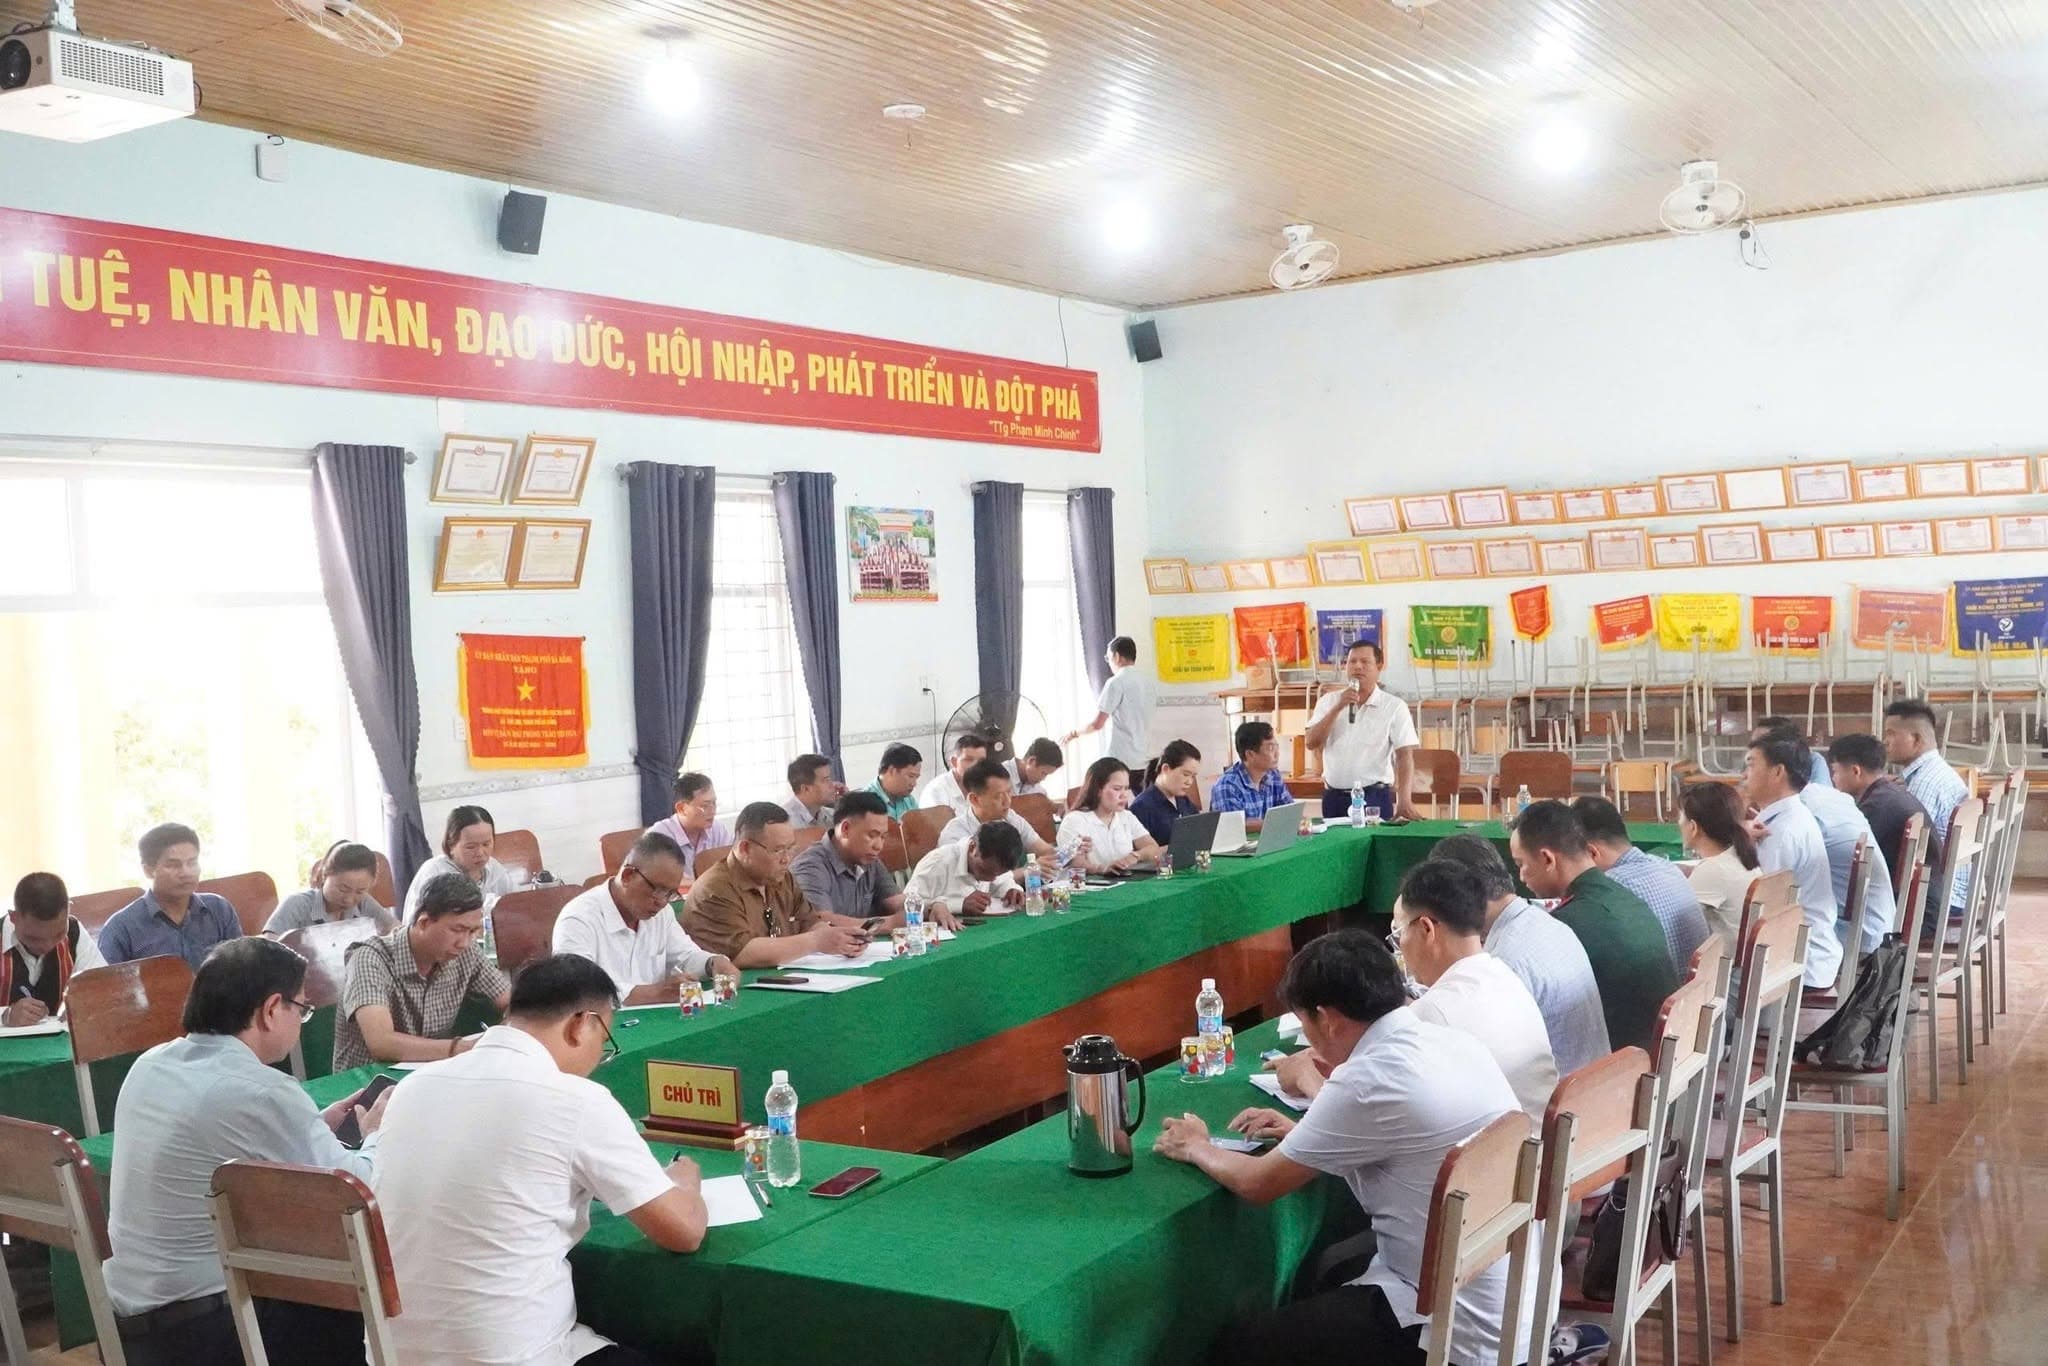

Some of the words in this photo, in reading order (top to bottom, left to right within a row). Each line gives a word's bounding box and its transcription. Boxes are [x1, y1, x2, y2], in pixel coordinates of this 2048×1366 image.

[24, 248, 151, 328] TUỆ,
[168, 267, 320, 337] NHÂN
[332, 283, 443, 358] VĂN,
[454, 306, 537, 368] ĐẠO
[551, 314, 636, 377] ĐỨC,
[646, 326, 702, 388] HỘI
[712, 338, 799, 396] NHẬP,
[808, 350, 877, 400] PHÁT
[883, 356, 955, 408] TRIỂN
[960, 369, 990, 410] VÀ
[995, 374, 1036, 422] ĐỘT
[1041, 383, 1082, 421] PHÁ
[1034, 424, 1053, 439] Minh
[663, 1081, 693, 1104] CHỦ
[697, 1087, 721, 1107] TRÌ
